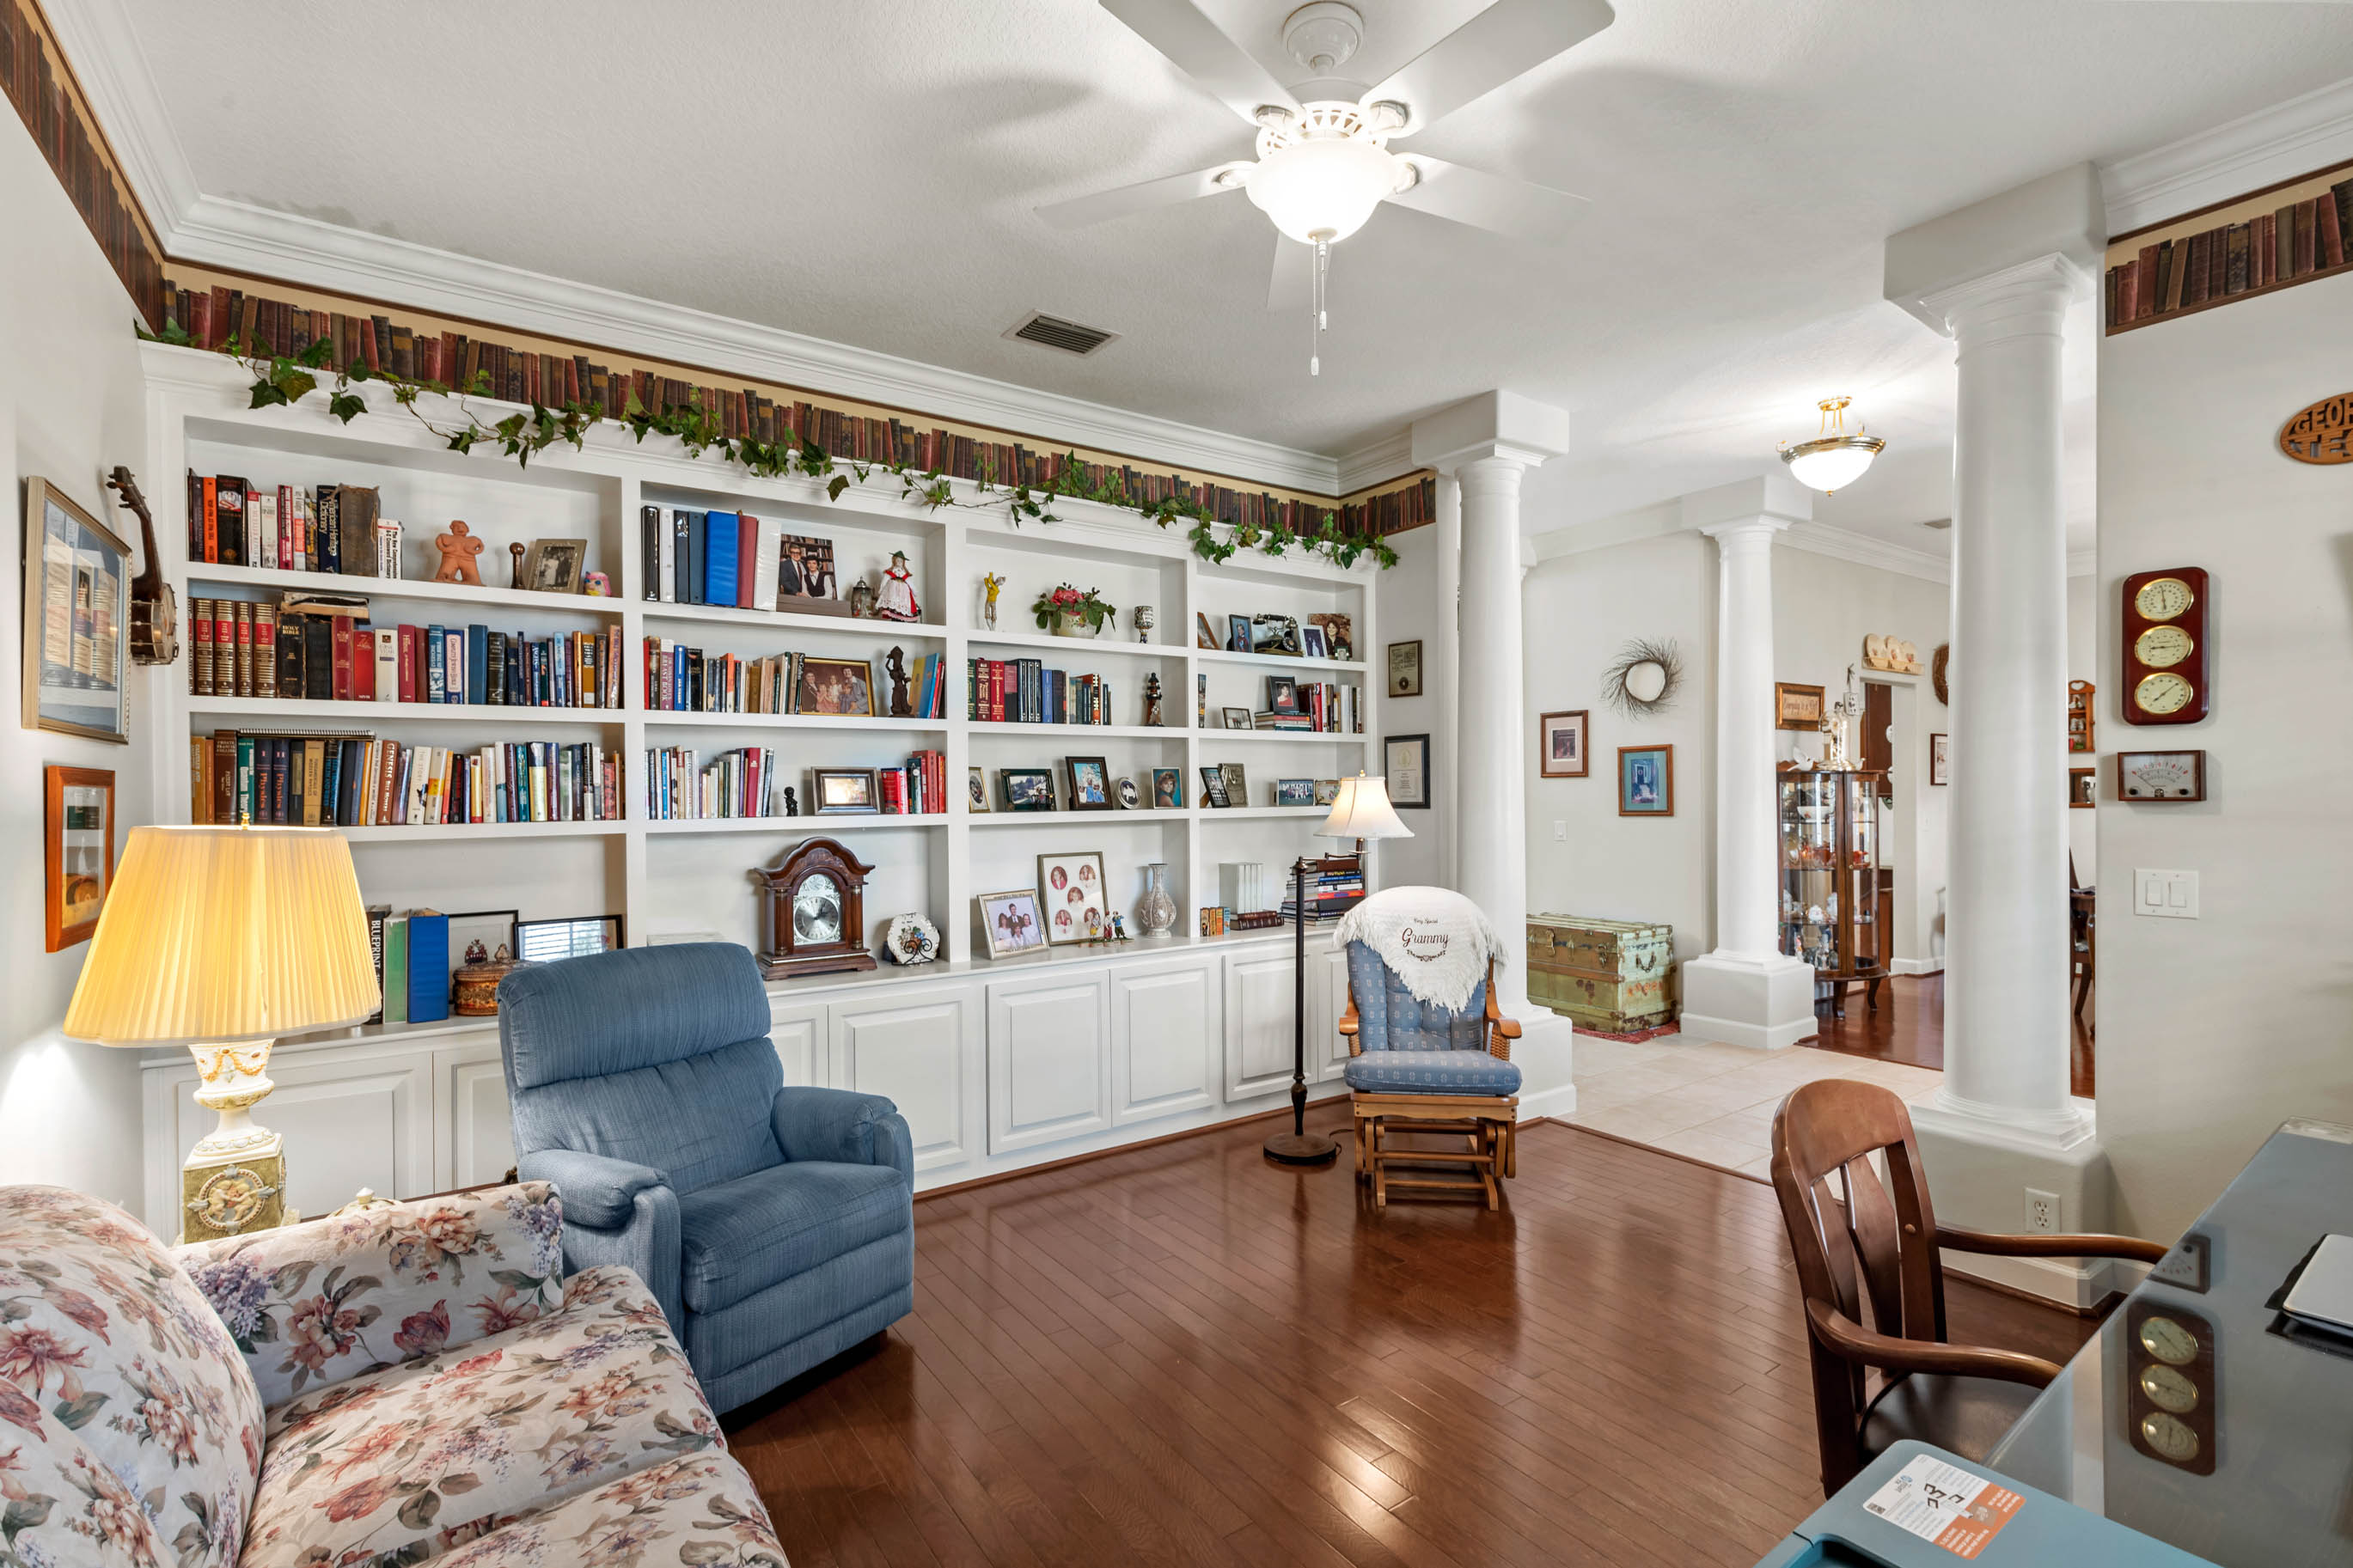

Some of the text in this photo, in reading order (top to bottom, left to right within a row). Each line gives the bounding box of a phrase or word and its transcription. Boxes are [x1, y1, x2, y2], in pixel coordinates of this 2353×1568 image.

[319, 501, 328, 534] Dictionary
[327, 500, 338, 556] American Heritage
[384, 742, 395, 778] GENESIS
[239, 766, 249, 813] Quantum Theory
[259, 772, 268, 809] Physics
[275, 772, 284, 809] Physics
[370, 920, 381, 968] BLUEPRINT
[1403, 928, 1450, 949] Grammy
